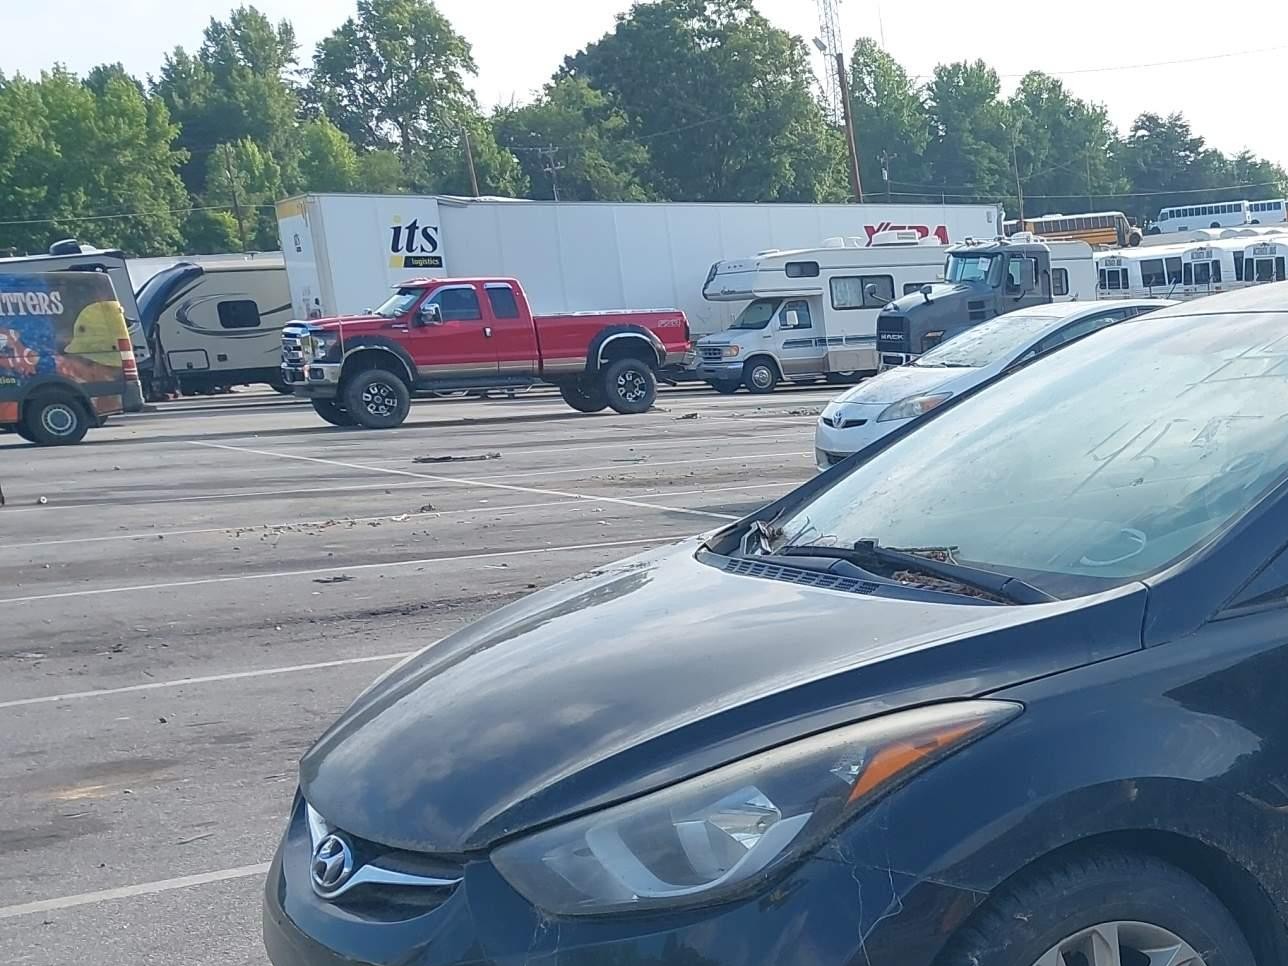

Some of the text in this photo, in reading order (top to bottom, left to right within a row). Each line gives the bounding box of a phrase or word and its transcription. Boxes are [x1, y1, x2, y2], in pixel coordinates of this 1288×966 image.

[389, 215, 438, 253] its
[411, 257, 440, 266] logistics
[880, 333, 904, 341] MACK
